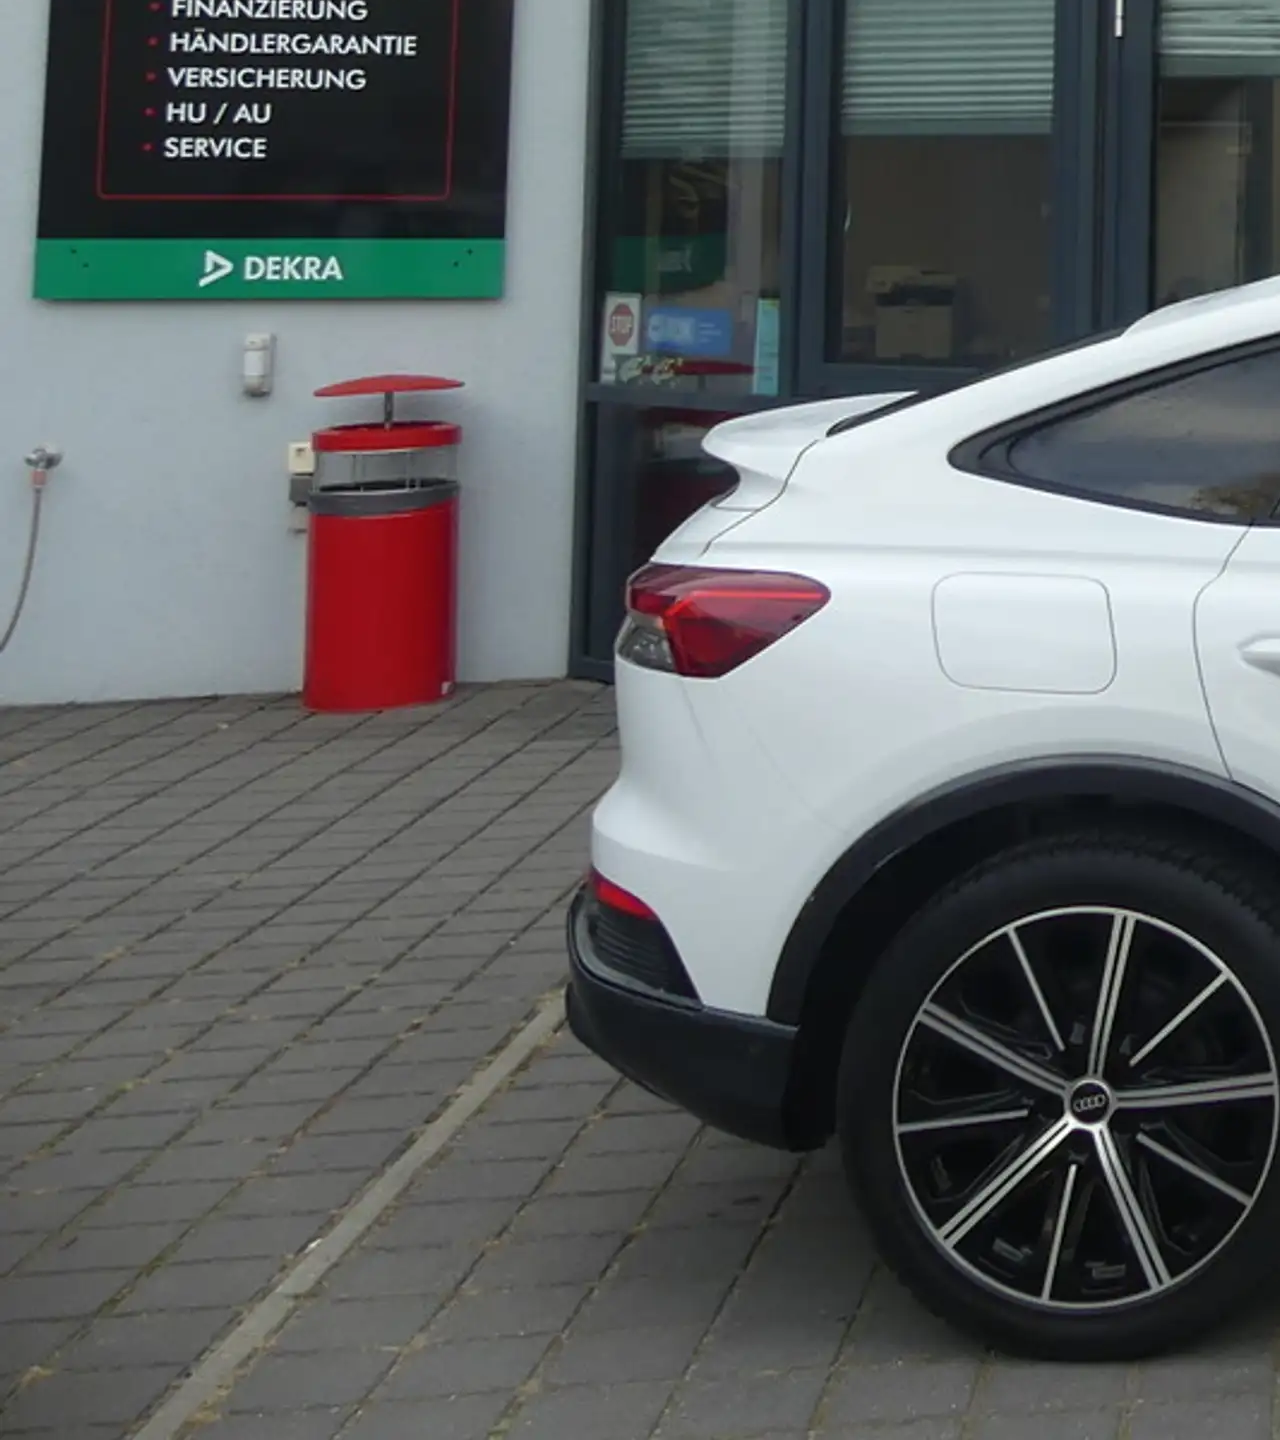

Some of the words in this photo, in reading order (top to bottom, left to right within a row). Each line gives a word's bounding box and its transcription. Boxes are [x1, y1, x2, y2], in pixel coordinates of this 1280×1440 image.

[170, 28, 418, 57] HÄNDLERGARANTIE
[167, 66, 367, 90] VERSICHERUNG
[166, 102, 206, 124] HU
[213, 102, 228, 126] /
[233, 103, 272, 125] AU
[164, 135, 268, 159] SERVICE
[243, 255, 343, 281] DEKRA
